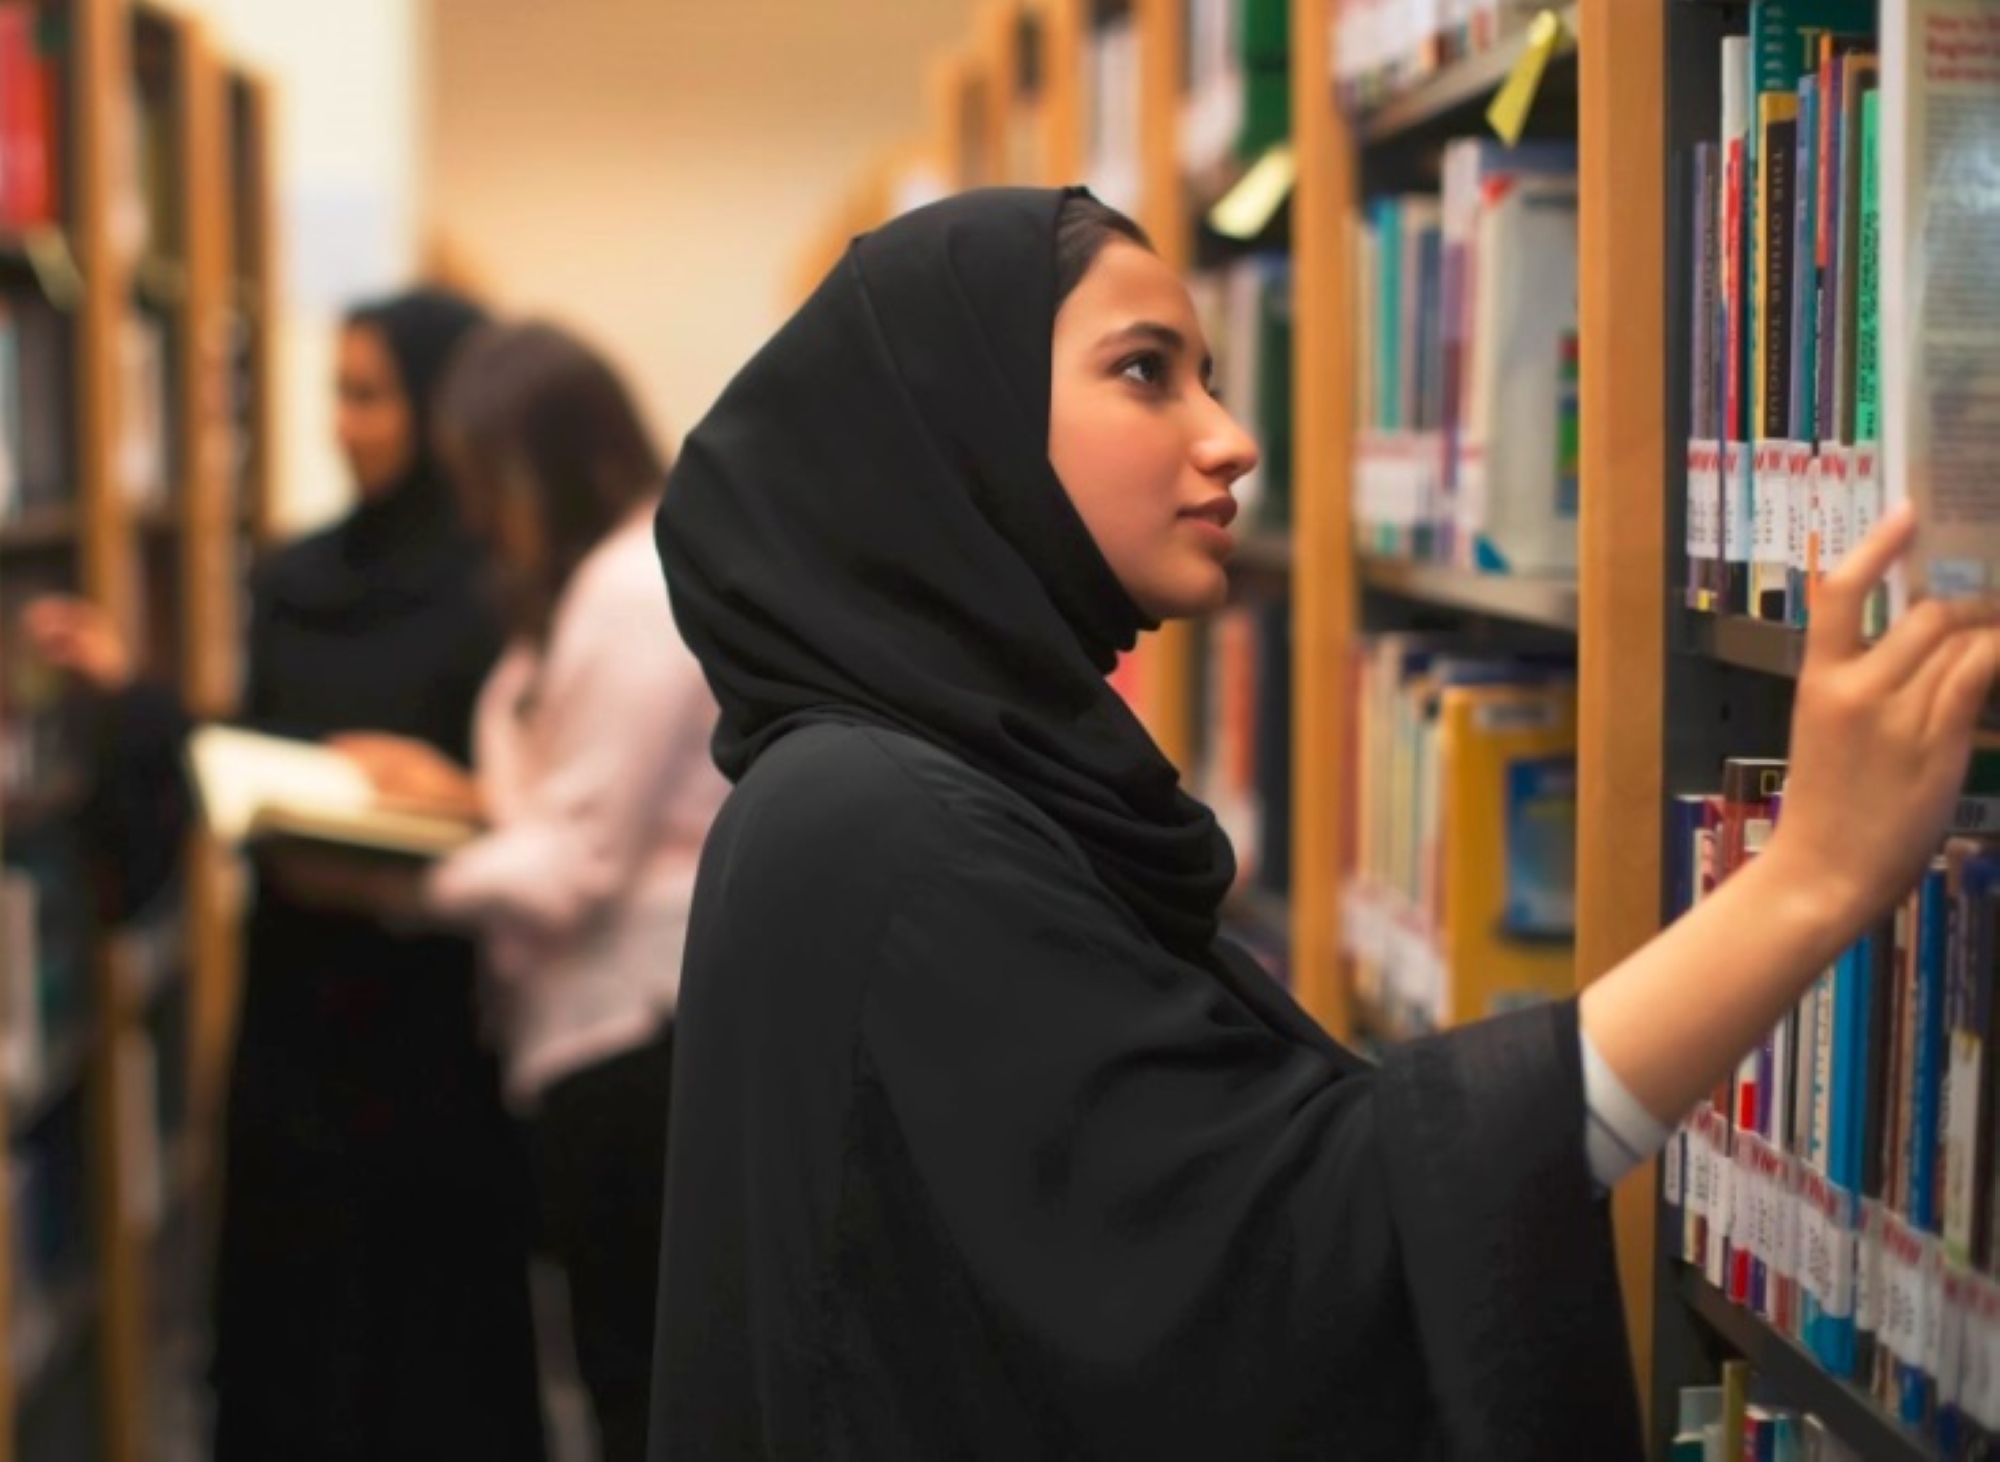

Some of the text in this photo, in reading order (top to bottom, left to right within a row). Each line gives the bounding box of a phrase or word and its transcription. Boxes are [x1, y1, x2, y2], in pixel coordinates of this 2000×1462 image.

[1768, 151, 1783, 431] THE OTHER TONGUE
